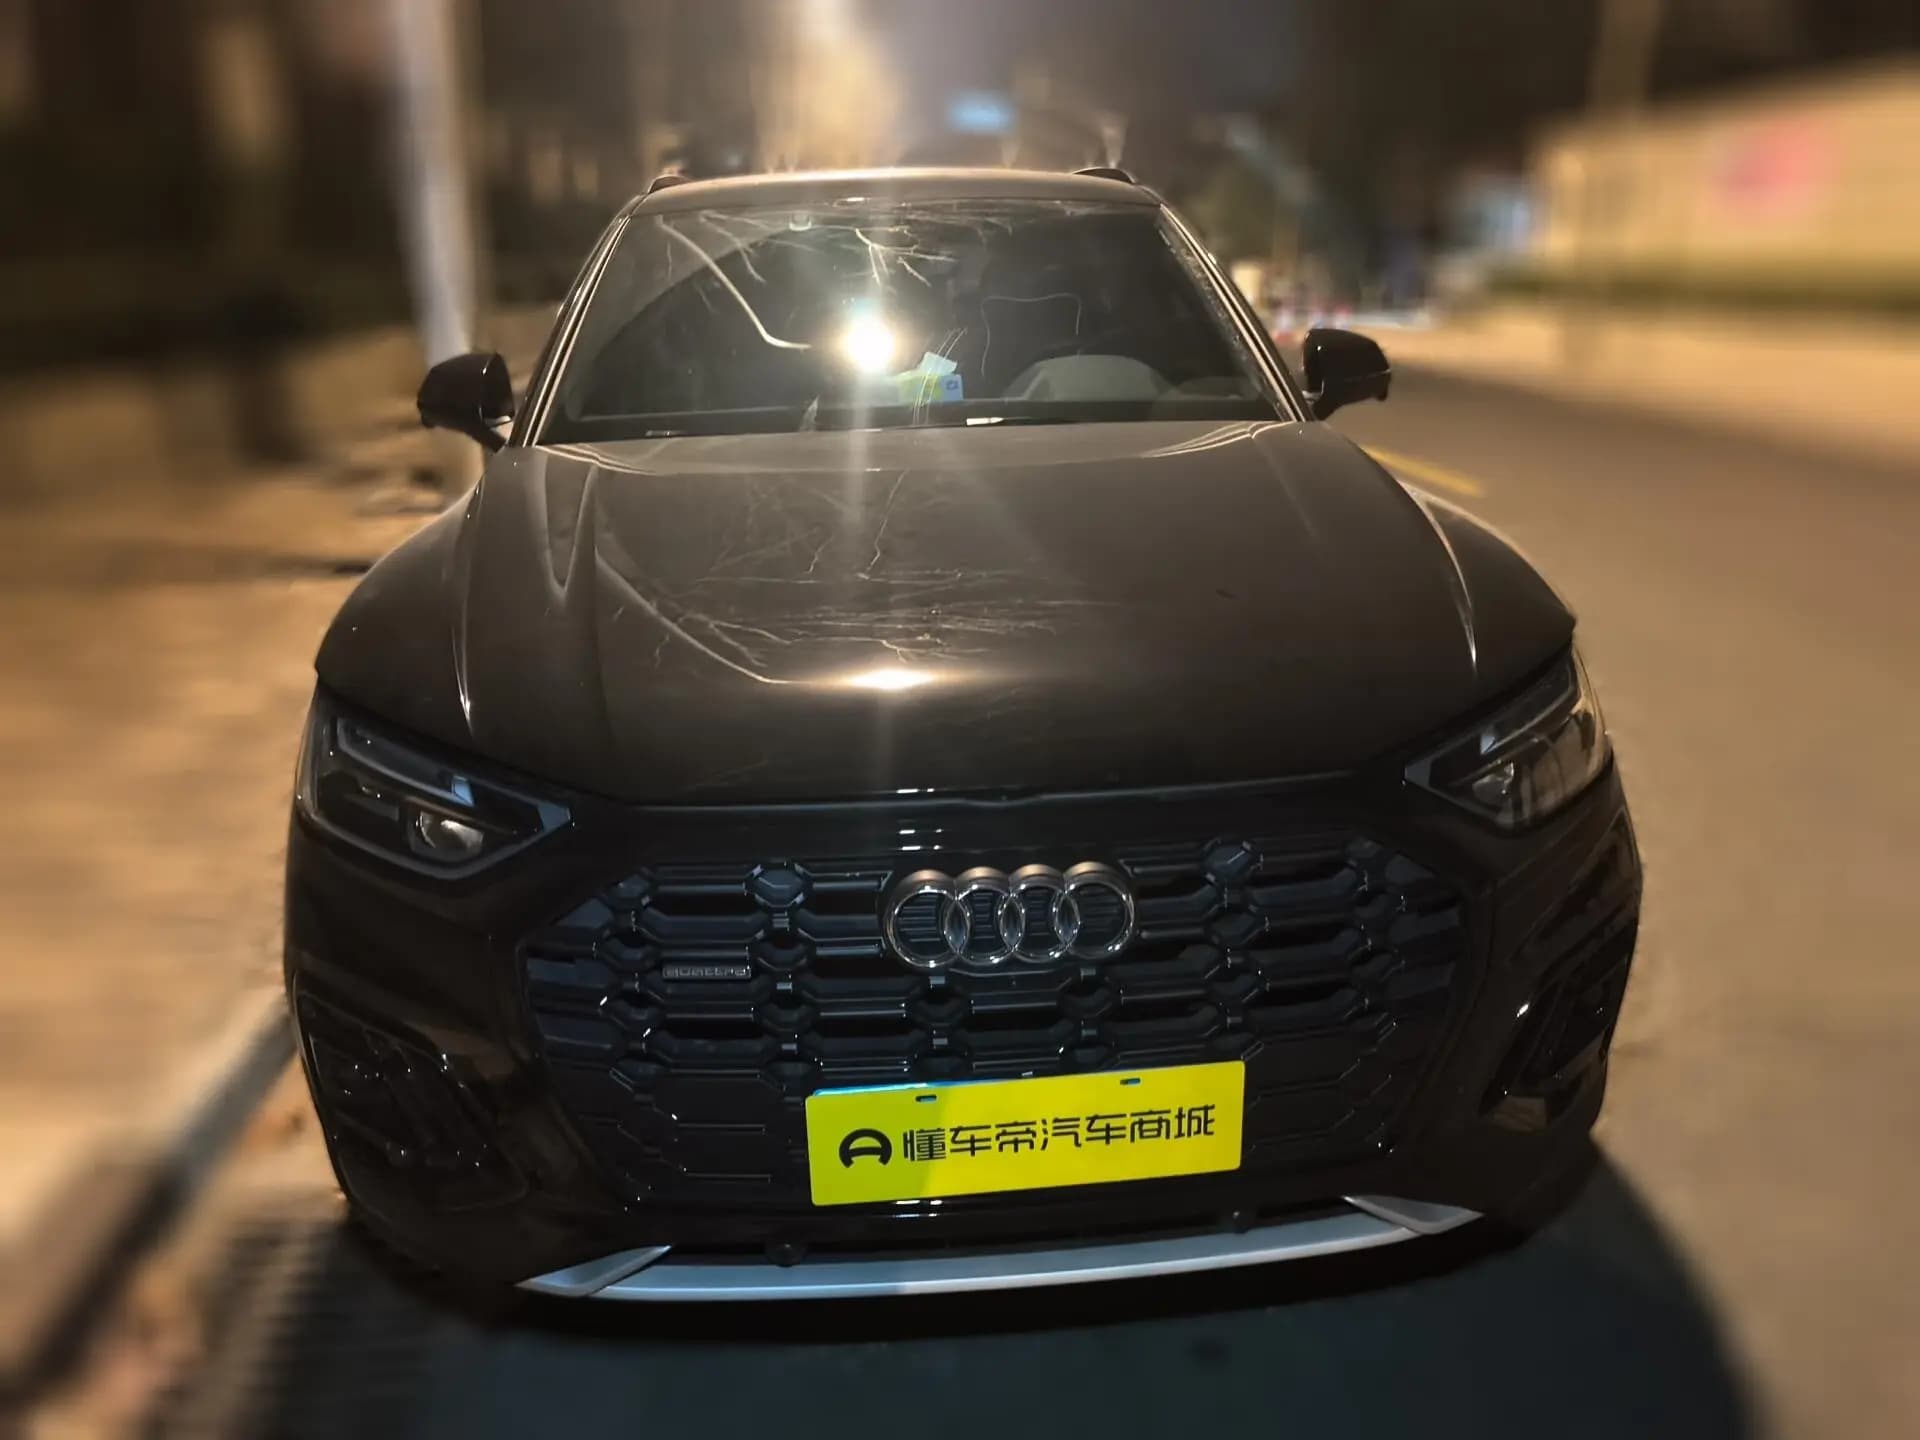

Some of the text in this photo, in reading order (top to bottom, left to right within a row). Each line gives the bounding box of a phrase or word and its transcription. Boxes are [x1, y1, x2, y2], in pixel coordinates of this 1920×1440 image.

[902, 1104, 1216, 1162] 懂车帝汽车商城
